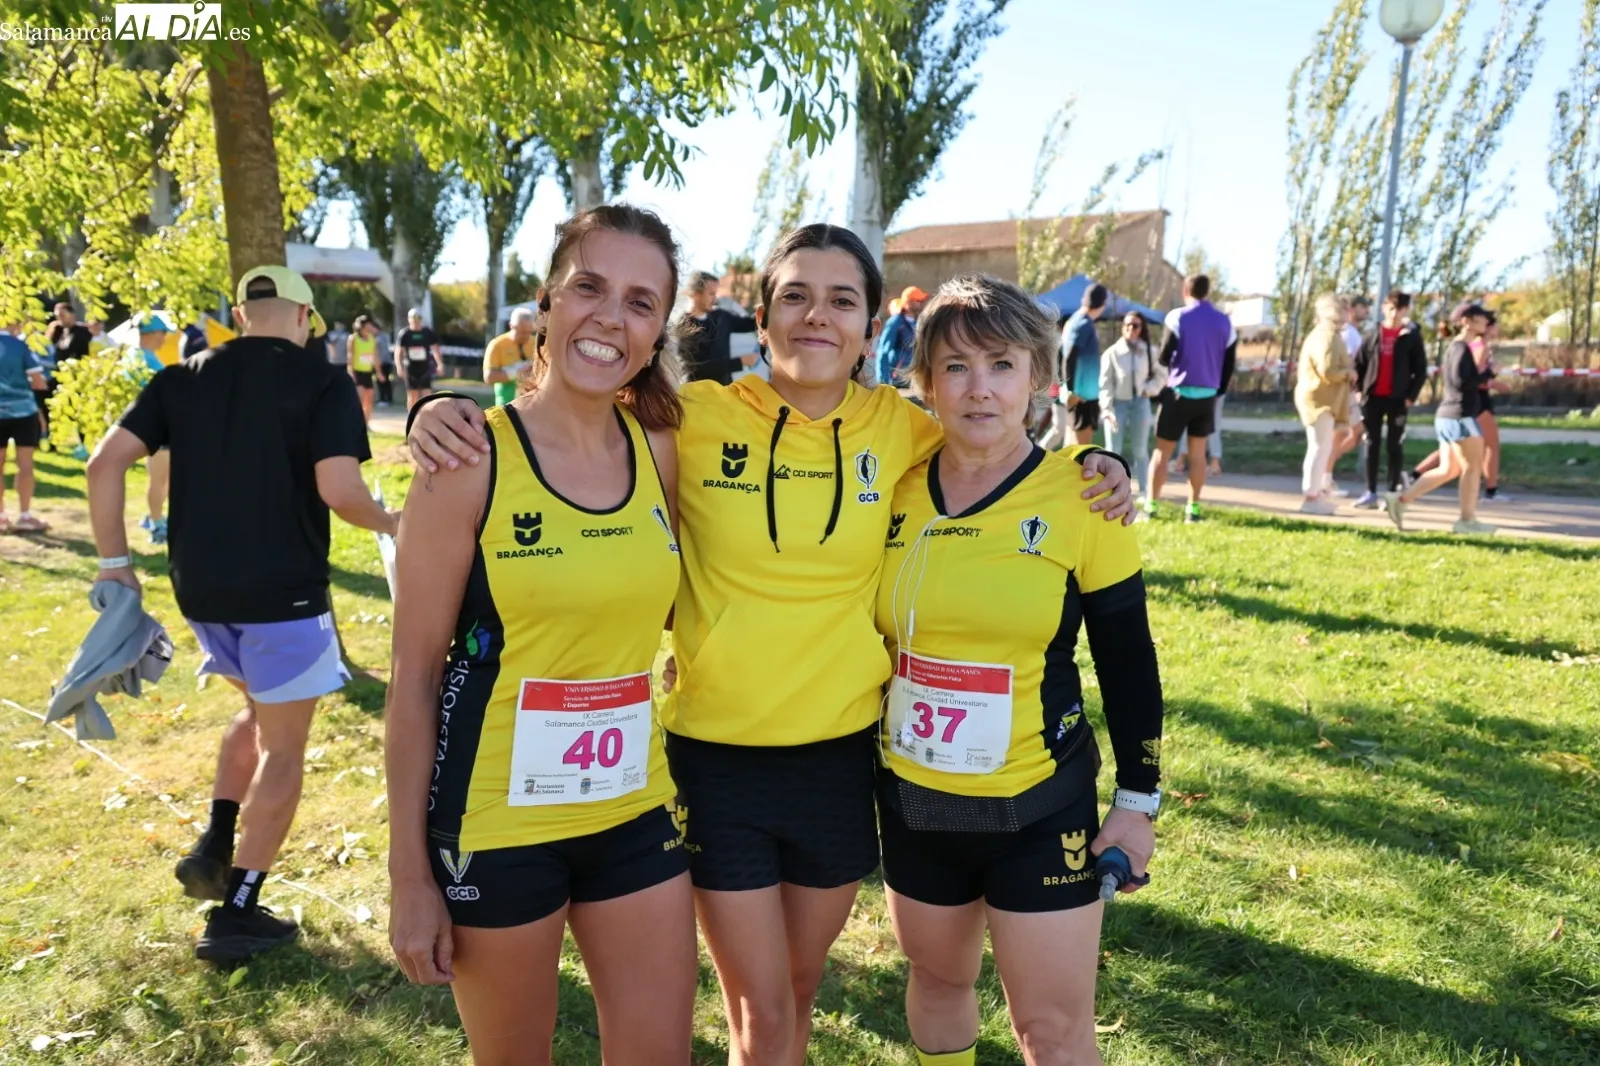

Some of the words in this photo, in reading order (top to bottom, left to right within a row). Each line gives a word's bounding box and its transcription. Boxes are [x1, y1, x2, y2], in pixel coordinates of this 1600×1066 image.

[792, 470, 806, 478] CCI
[808, 471, 834, 479] SPORT
[703, 479, 761, 493] BRAGANÇA
[858, 492, 880, 503] GCB
[581, 528, 600, 538] CCI
[601, 526, 634, 537] SPORT
[496, 547, 563, 559] BRAGANÇA
[544, 719, 586, 728] Salamanca
[912, 701, 967, 744] 37
[562, 727, 624, 770] 40
[1043, 868, 1096, 886] BRAGANÇ
[233, 884, 251, 908] NIKE
[449, 887, 478, 899] GCB
